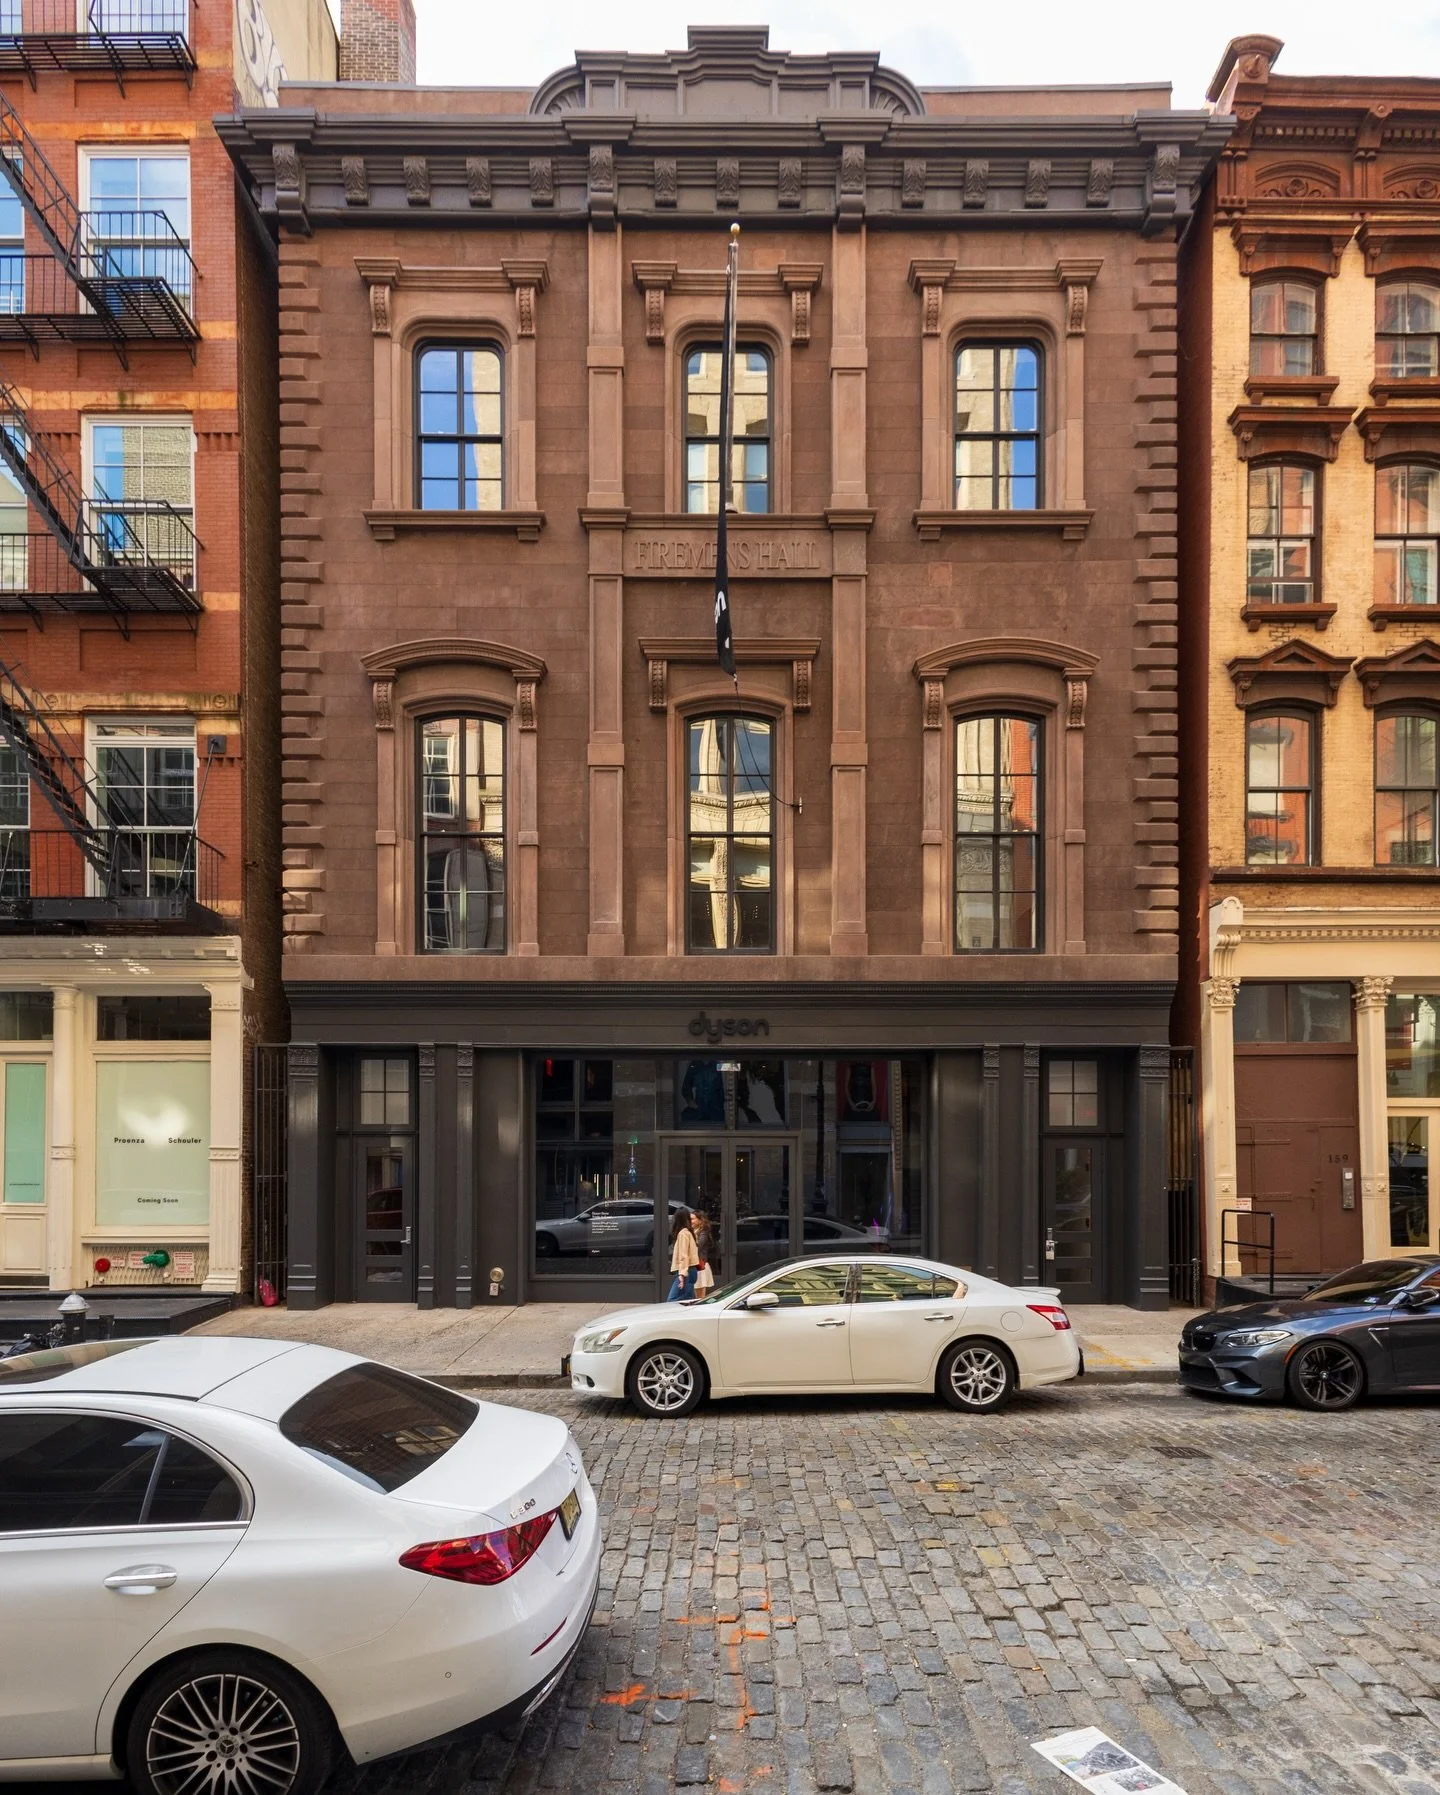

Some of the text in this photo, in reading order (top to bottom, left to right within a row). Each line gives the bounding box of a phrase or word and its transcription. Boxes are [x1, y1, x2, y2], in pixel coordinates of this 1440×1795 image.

[757, 542, 821, 570] HALL
[688, 1011, 770, 1044] dyson
[1327, 1154, 1349, 1164] 159
